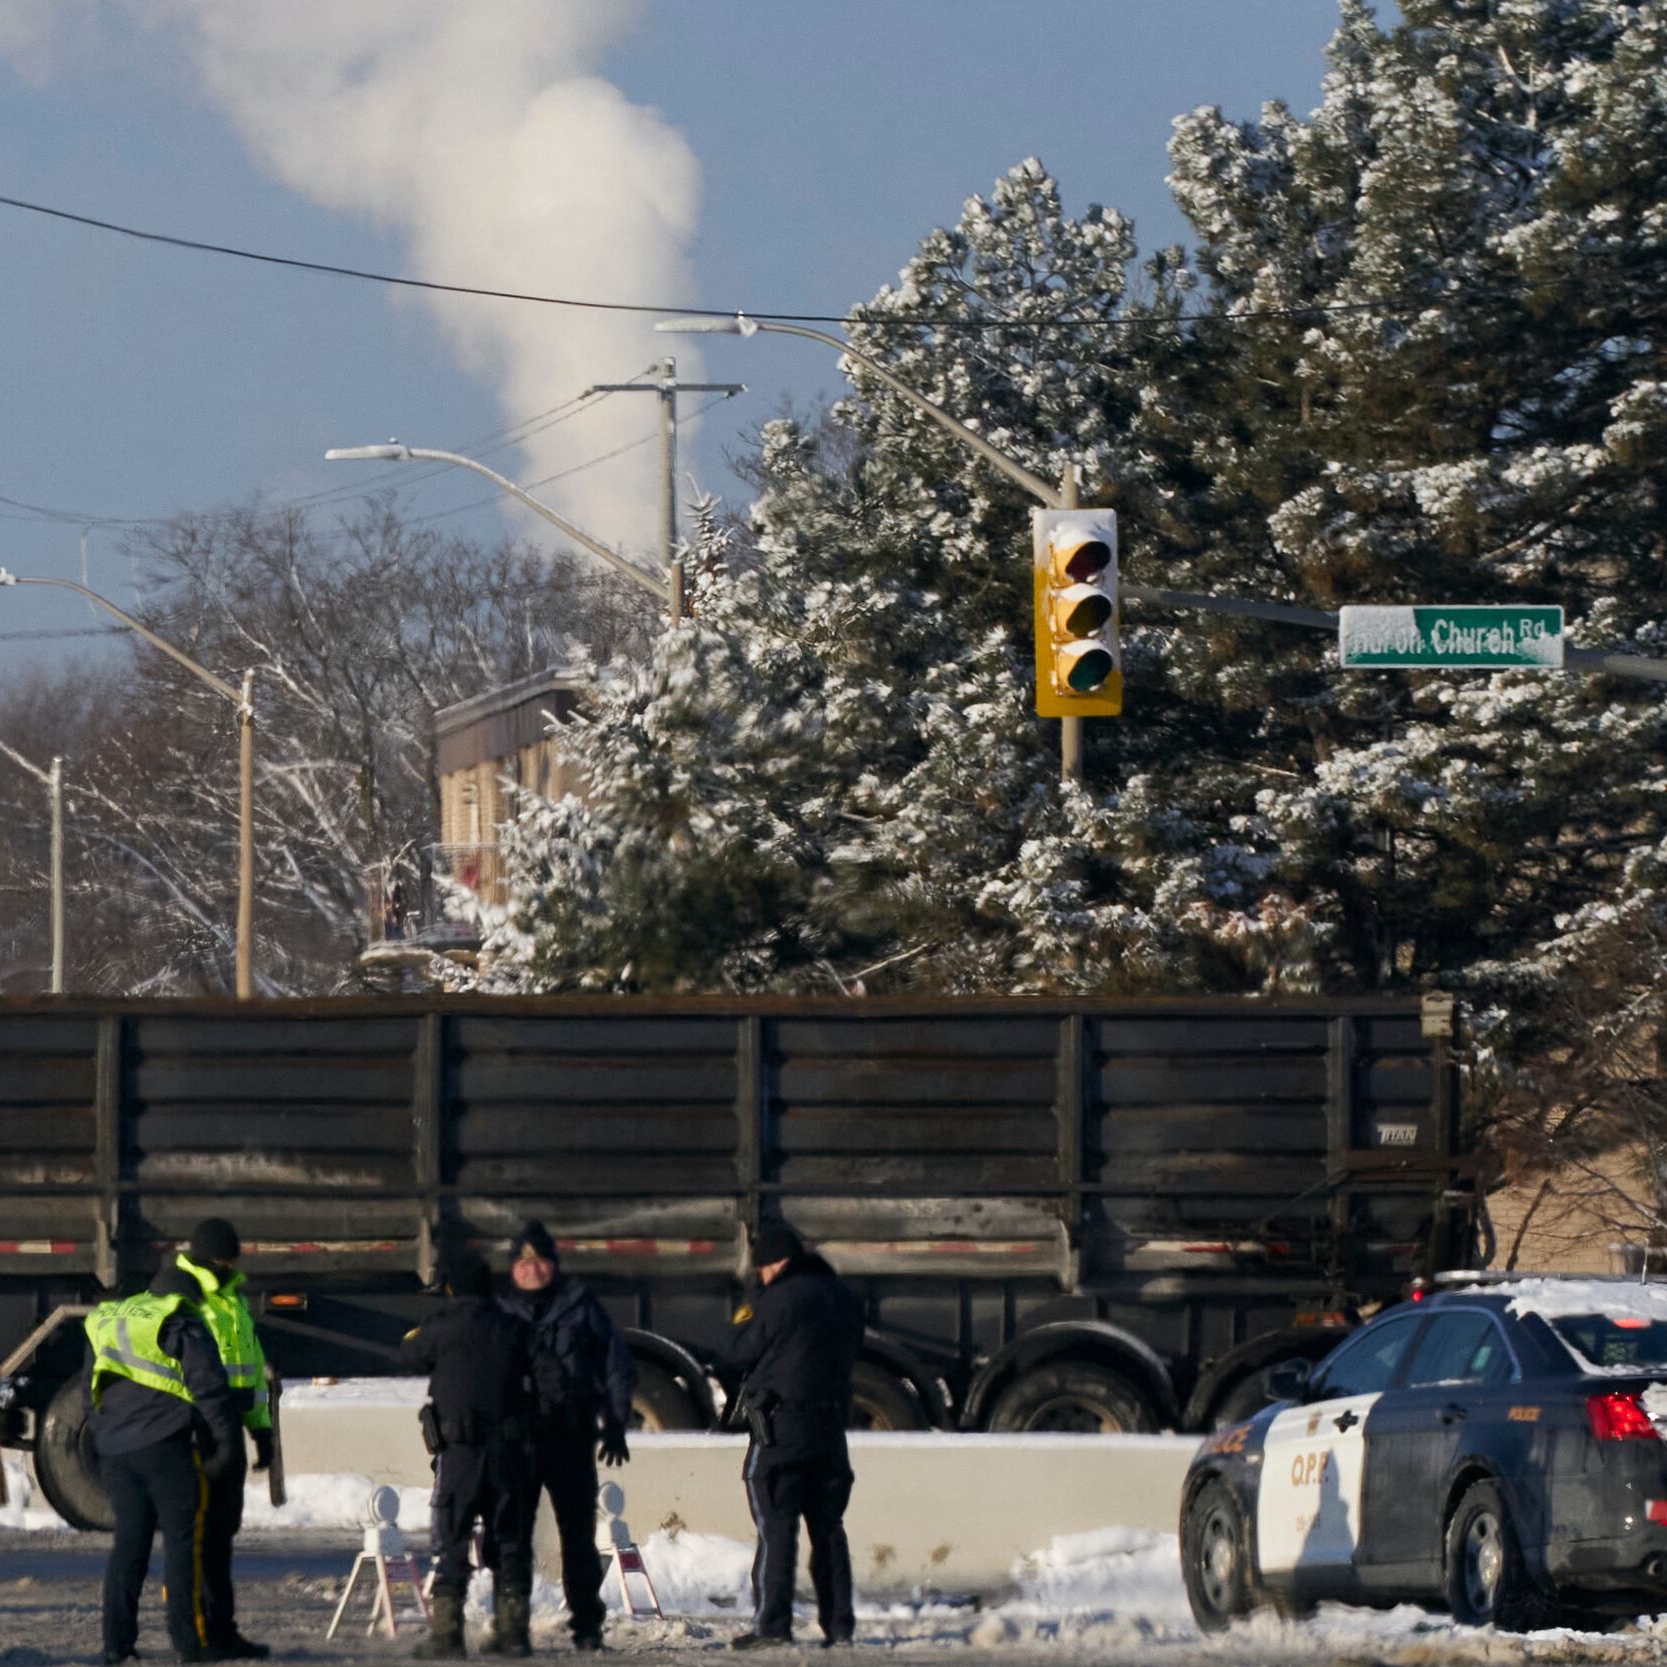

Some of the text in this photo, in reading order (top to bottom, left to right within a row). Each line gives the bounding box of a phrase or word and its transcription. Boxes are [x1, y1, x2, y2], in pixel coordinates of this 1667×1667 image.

[1431, 617, 1516, 656] Church
[1377, 1123, 1418, 1146] TITAN
[1291, 1451, 1330, 1488] O.P.P.
